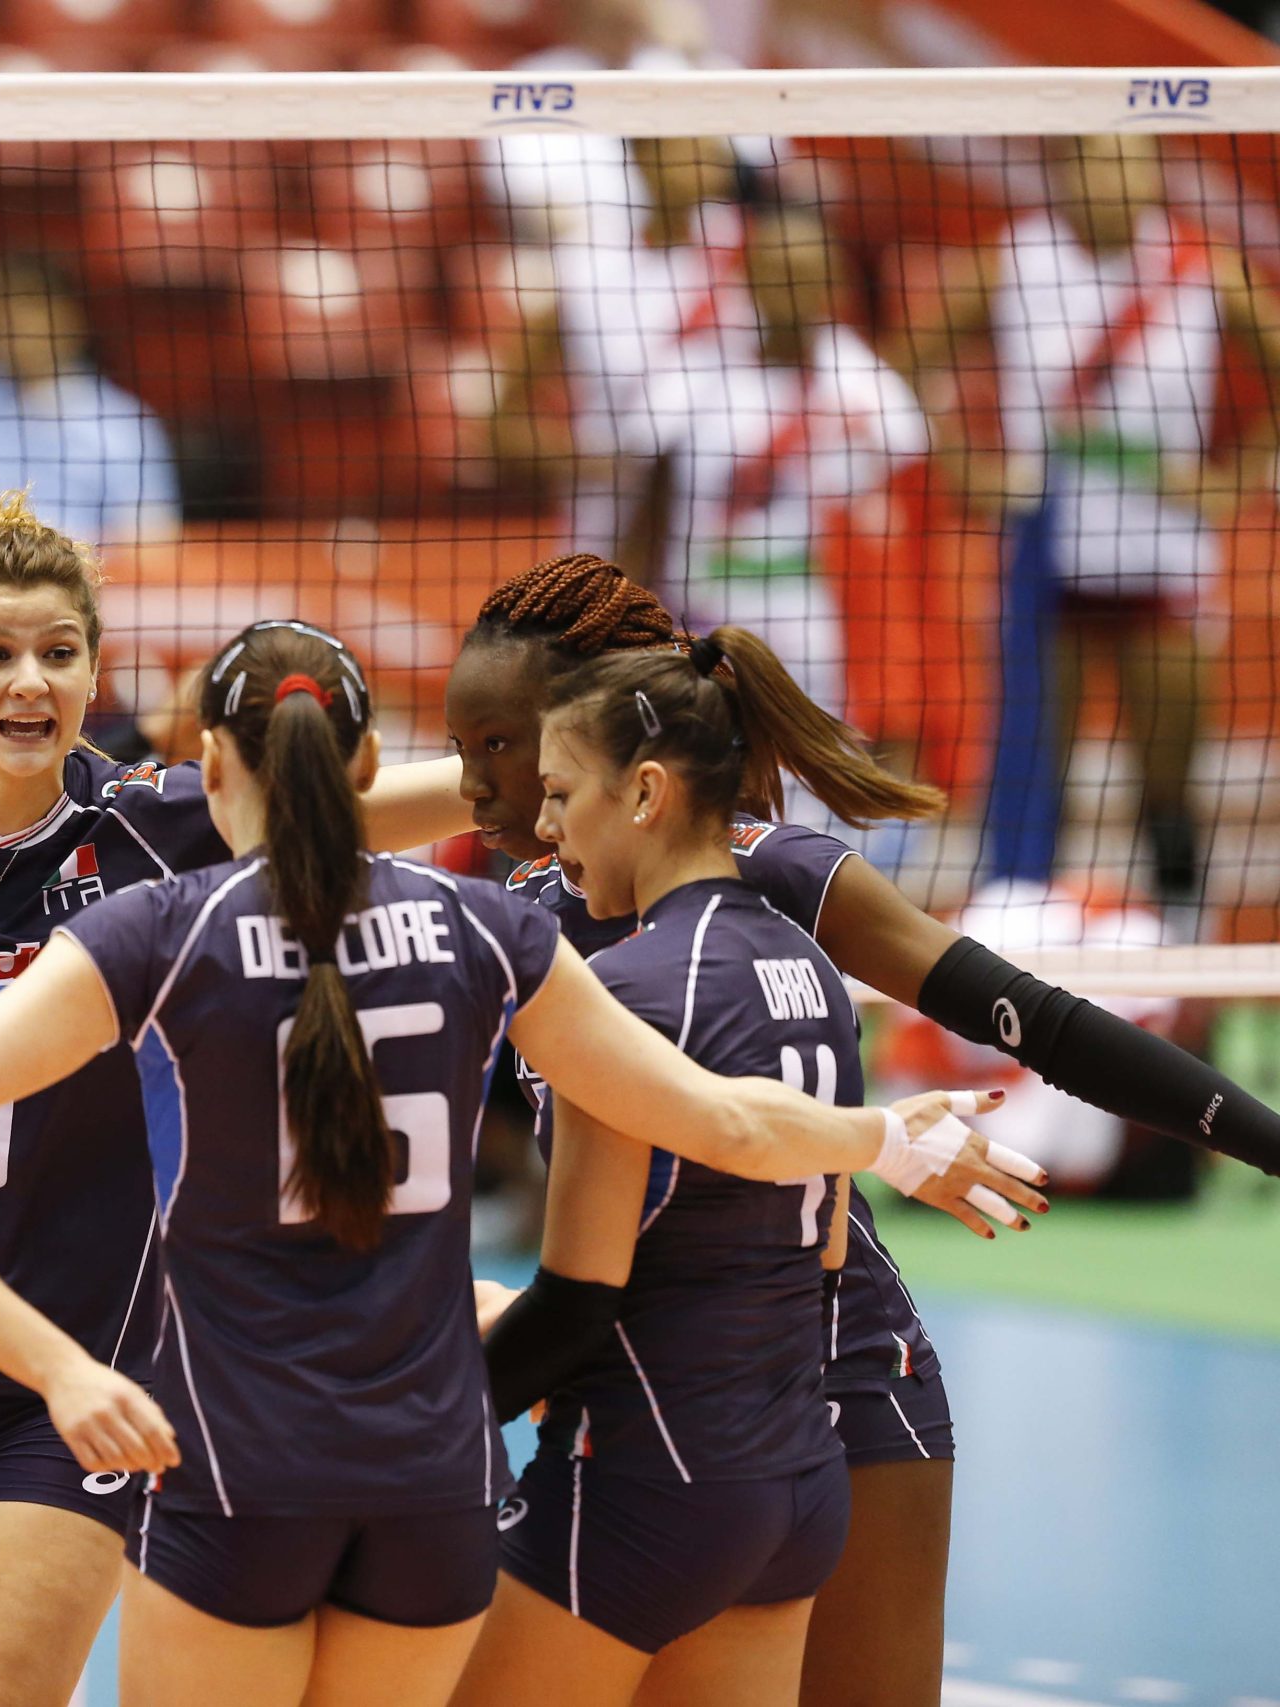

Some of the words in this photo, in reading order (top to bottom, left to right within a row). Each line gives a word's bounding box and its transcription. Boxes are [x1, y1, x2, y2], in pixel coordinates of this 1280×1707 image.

[492, 83, 574, 111] FIVB
[1128, 79, 1209, 107] FIVB
[236, 914, 309, 980] DE
[334, 899, 456, 978] CORE
[753, 958, 829, 1021] ORRO
